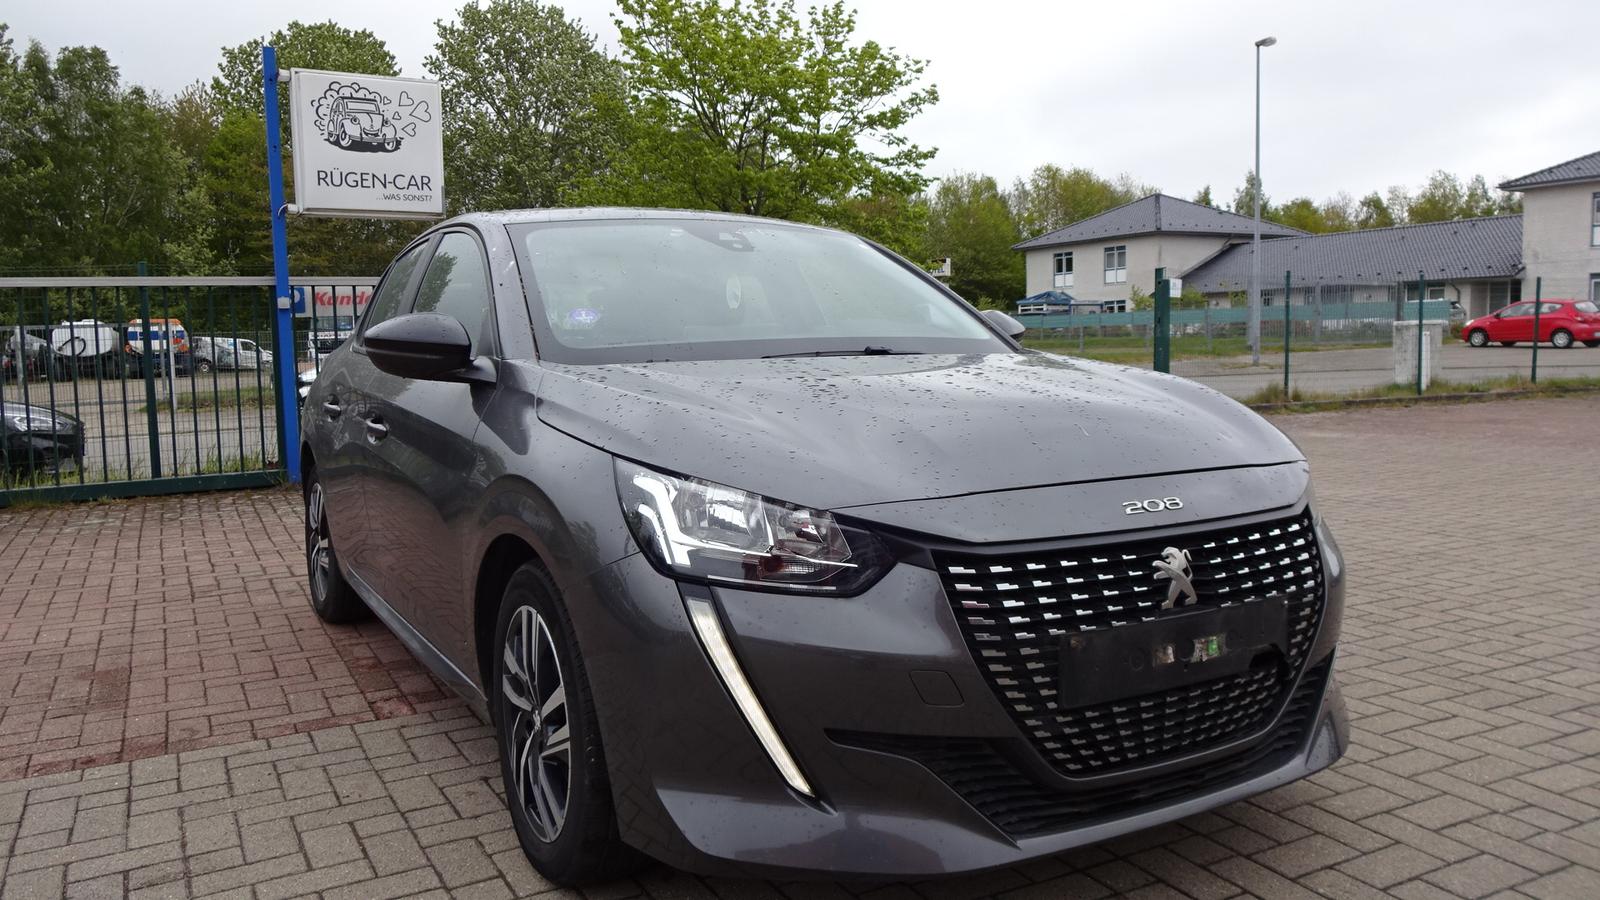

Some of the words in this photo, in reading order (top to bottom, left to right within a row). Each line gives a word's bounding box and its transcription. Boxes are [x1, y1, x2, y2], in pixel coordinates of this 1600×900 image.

[317, 167, 432, 191] RÜGEN-CAR
[402, 193, 433, 202] SONST?
[1122, 497, 1183, 515] 208
